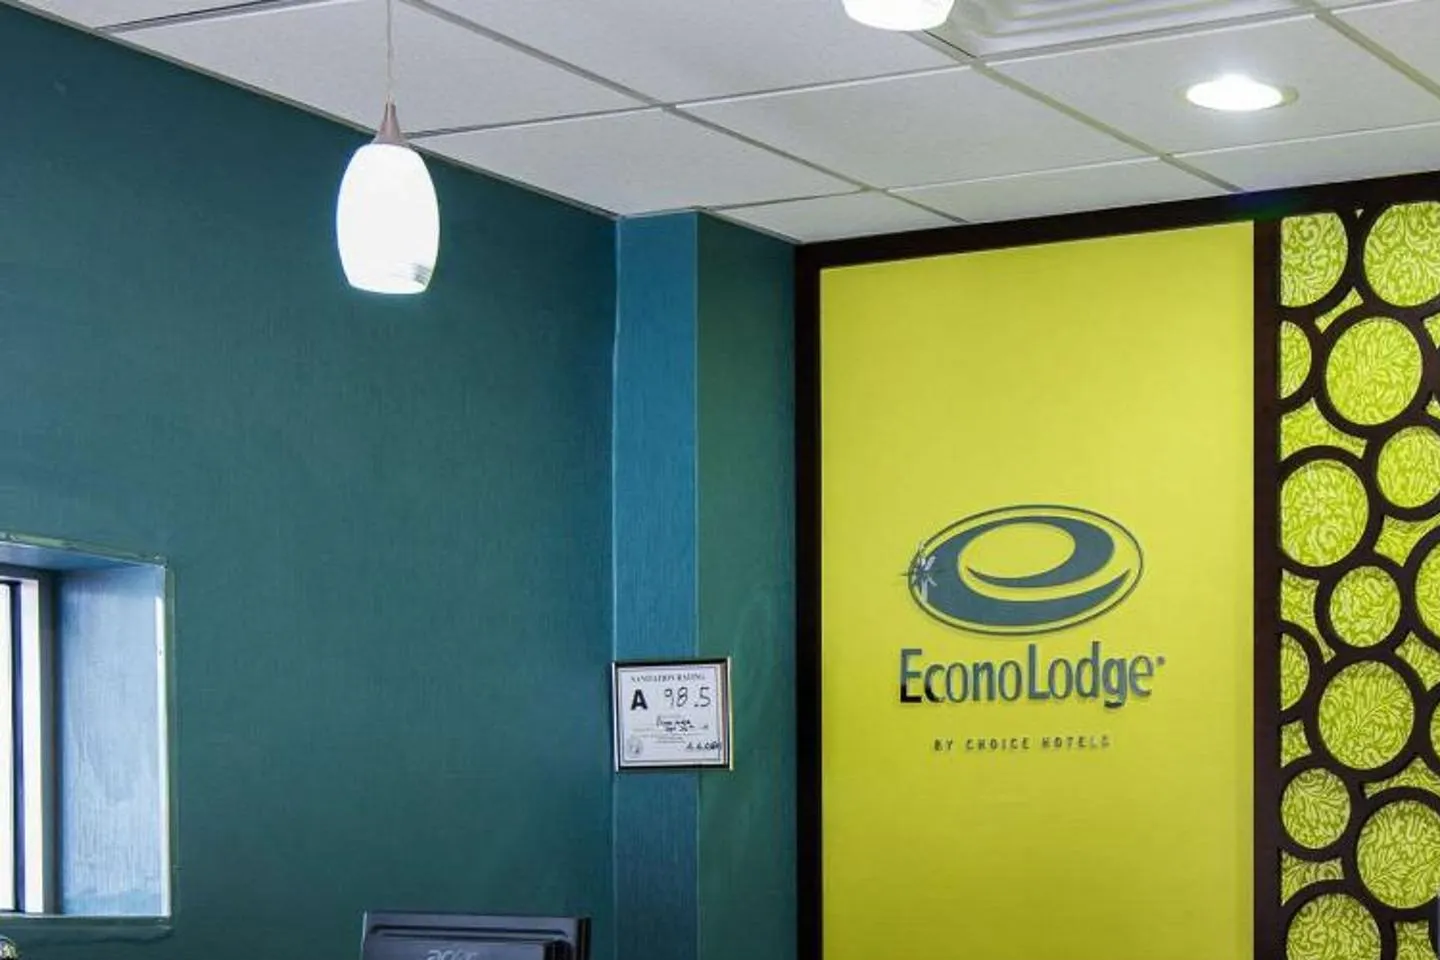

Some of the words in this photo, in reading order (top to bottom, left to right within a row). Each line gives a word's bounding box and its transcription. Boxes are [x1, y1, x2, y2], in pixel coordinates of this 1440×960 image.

[630, 688, 648, 711] A
[934, 738, 954, 752] BY
[965, 736, 1030, 751] CHOICE
[1041, 734, 1111, 750] HOTELS
